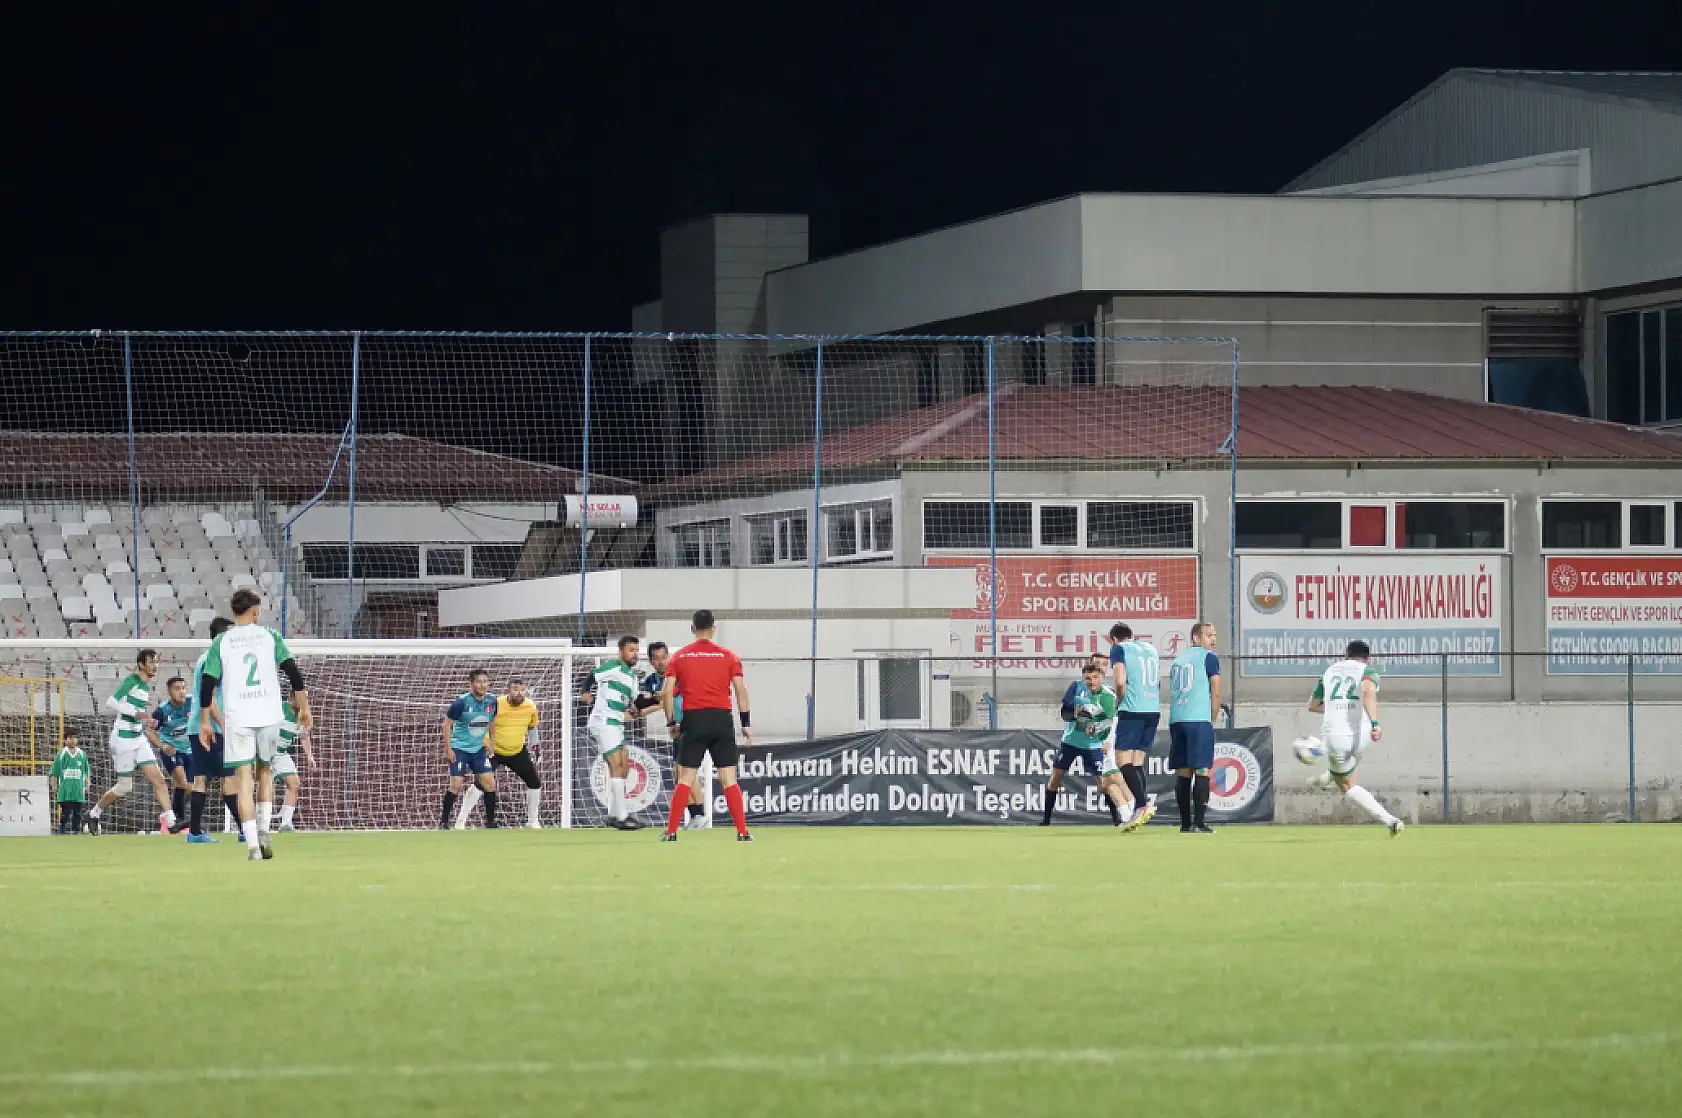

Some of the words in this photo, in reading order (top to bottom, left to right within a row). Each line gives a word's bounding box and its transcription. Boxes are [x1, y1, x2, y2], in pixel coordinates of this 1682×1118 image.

[1022, 573, 1051, 587] T.C.
[1058, 569, 1131, 590] GENÇLİK
[1134, 572, 1157, 587] VE
[1296, 564, 1362, 620] FETHİYE
[1366, 564, 1492, 619] KAYMAKAMLIĞI
[1581, 571, 1600, 586] T.C.
[1602, 569, 1647, 590] GENÇLİK
[1650, 571, 1664, 586] VE
[1022, 597, 1069, 612] SPOR
[1074, 592, 1168, 612] BAKANLIĞI
[1552, 603, 1588, 621] FETHİYE
[1591, 603, 1629, 625] GENÇLİK
[1631, 605, 1642, 621] VE
[1644, 605, 1668, 621] SPOR
[976, 624, 1009, 633] MULA
[1248, 631, 1304, 666] FETHİYE
[1442, 630, 1495, 665] DİLERİZ
[1552, 630, 1599, 665] FETHİYE
[242, 652, 262, 686] 2
[1137, 656, 1158, 687] 10
[1330, 676, 1359, 701] 22
[738, 752, 832, 778] Lokman
[842, 747, 918, 775] Hekim
[926, 748, 1000, 775] ESNAF
[889, 783, 965, 818] Dolayı
